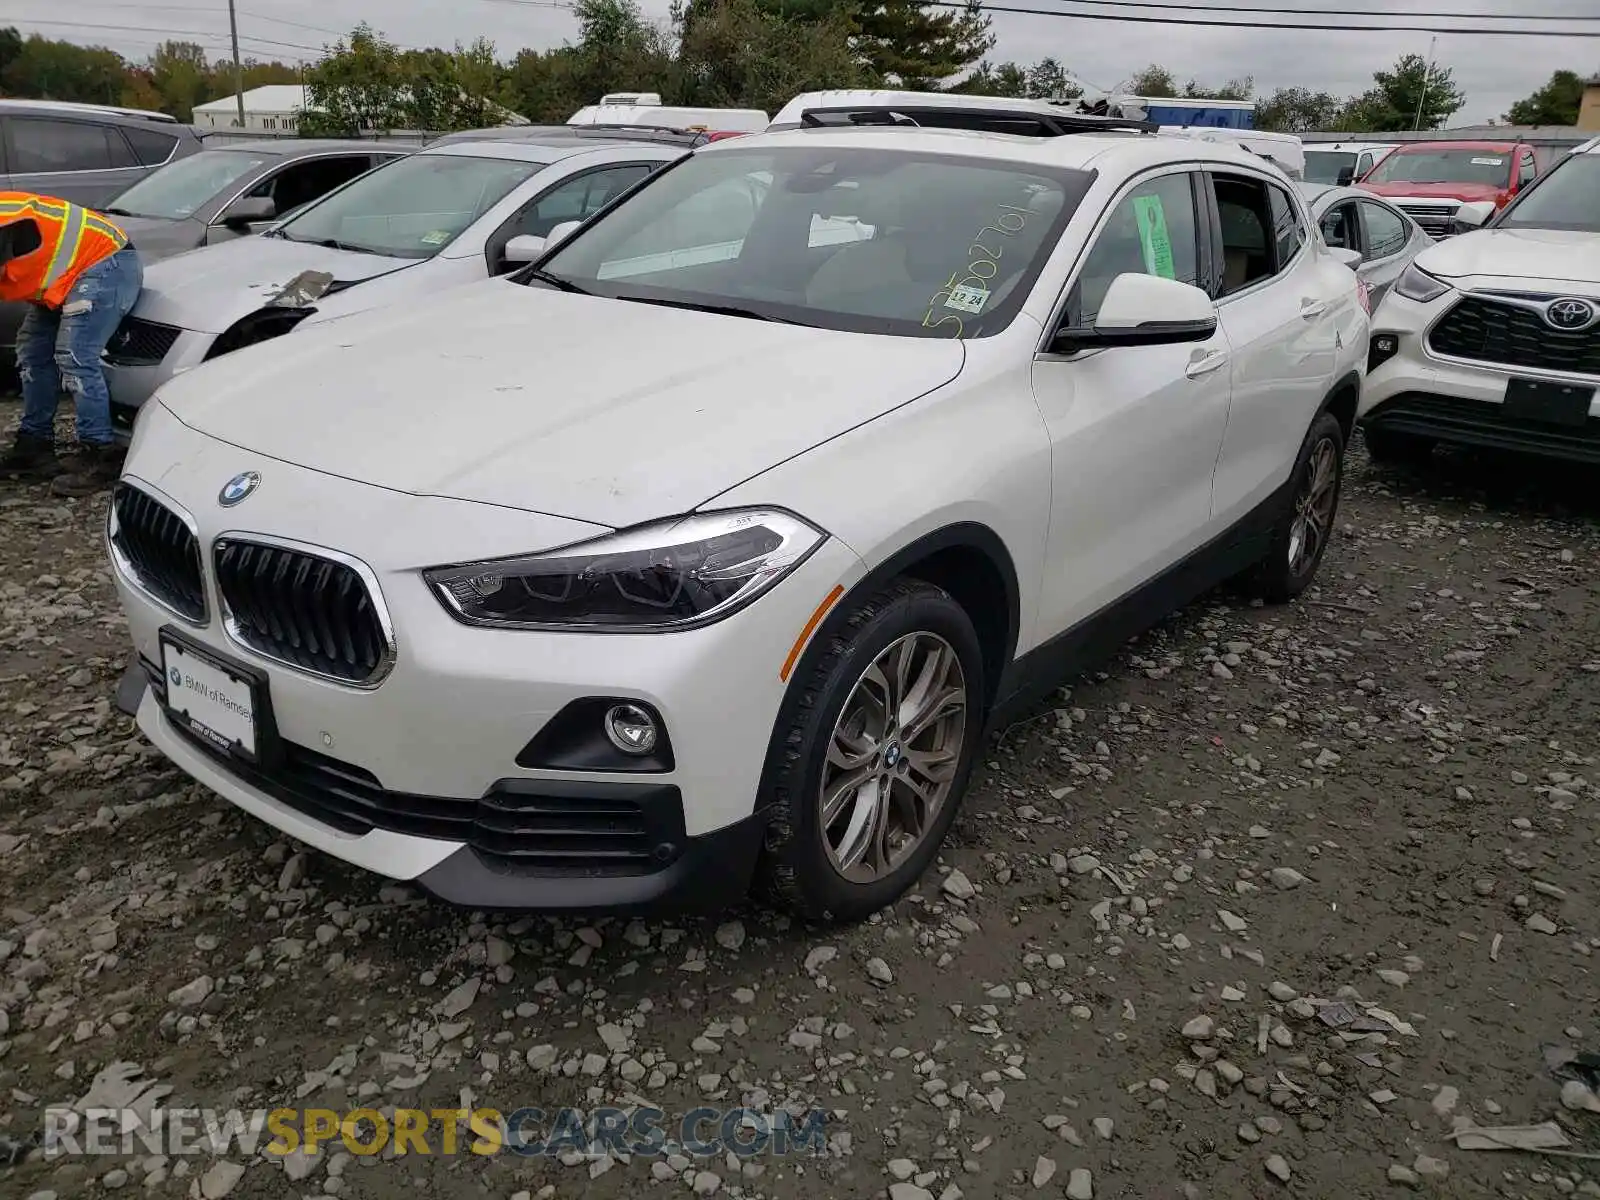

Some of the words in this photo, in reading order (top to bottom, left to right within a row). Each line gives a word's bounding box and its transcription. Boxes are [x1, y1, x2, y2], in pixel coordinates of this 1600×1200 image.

[969, 294, 984, 306] 24
[185, 675, 208, 697] BMW
[209, 689, 219, 702] of
[219, 691, 253, 723] Ramsey
